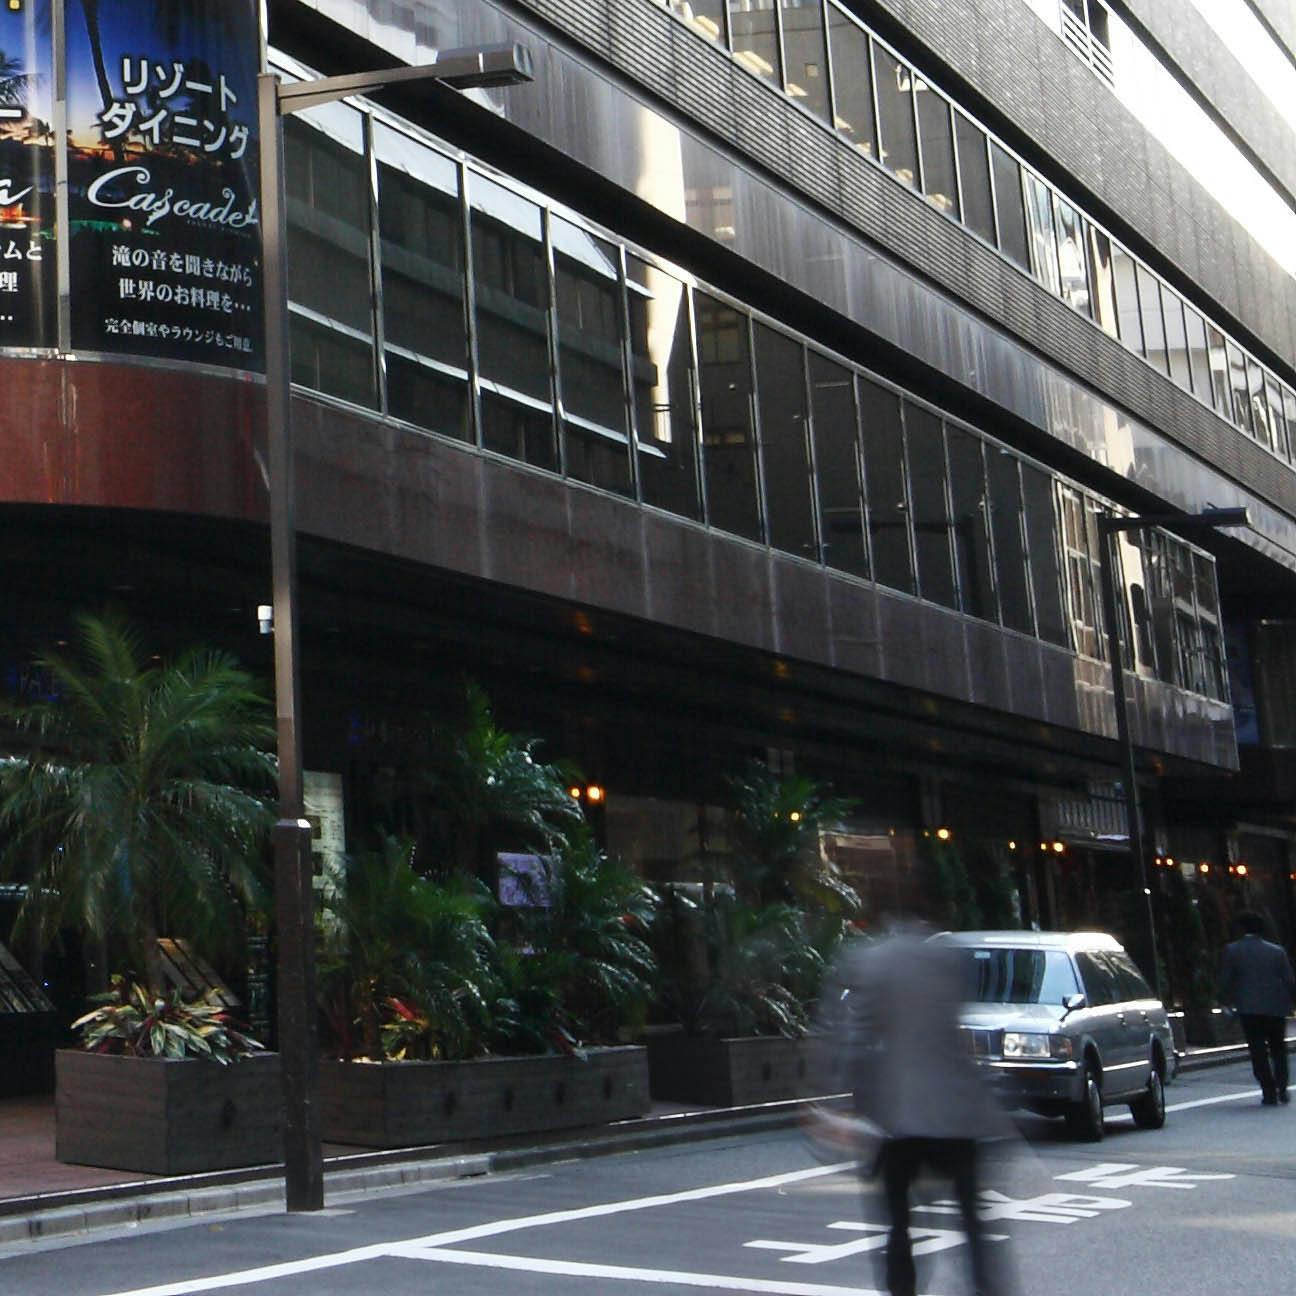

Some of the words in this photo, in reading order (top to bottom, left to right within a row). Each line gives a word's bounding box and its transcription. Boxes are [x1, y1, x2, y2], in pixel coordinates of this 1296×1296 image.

[119, 58, 239, 107] リゾート
[101, 105, 249, 159] ダイニング
[87, 165, 259, 229] Cascade
[112, 244, 253, 288] 滝の音を聞きながら
[742, 1163, 1236, 1265] 止まれ
